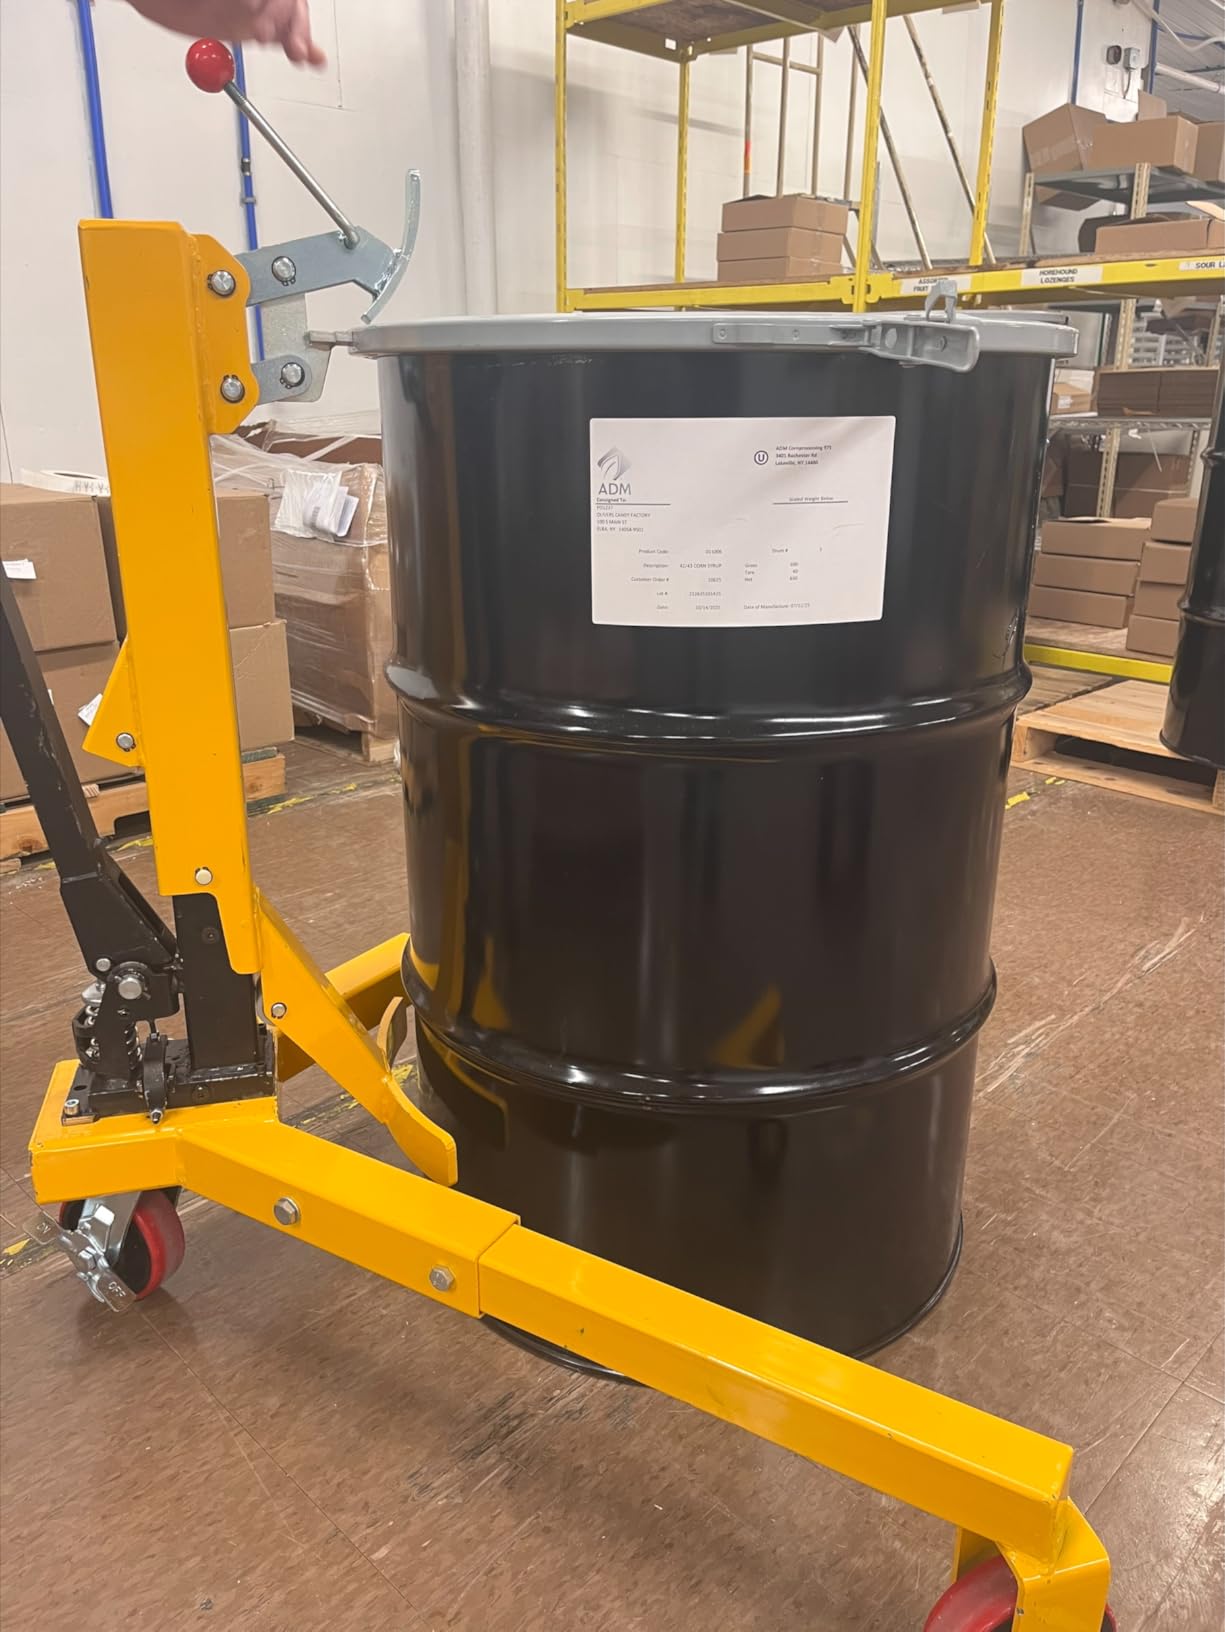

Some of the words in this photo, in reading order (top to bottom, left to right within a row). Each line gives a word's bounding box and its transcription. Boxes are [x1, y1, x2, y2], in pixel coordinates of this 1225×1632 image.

[598, 483, 632, 495] ADM
[36, 1222, 52, 1234] ON
[108, 1281, 126, 1297] OFF
